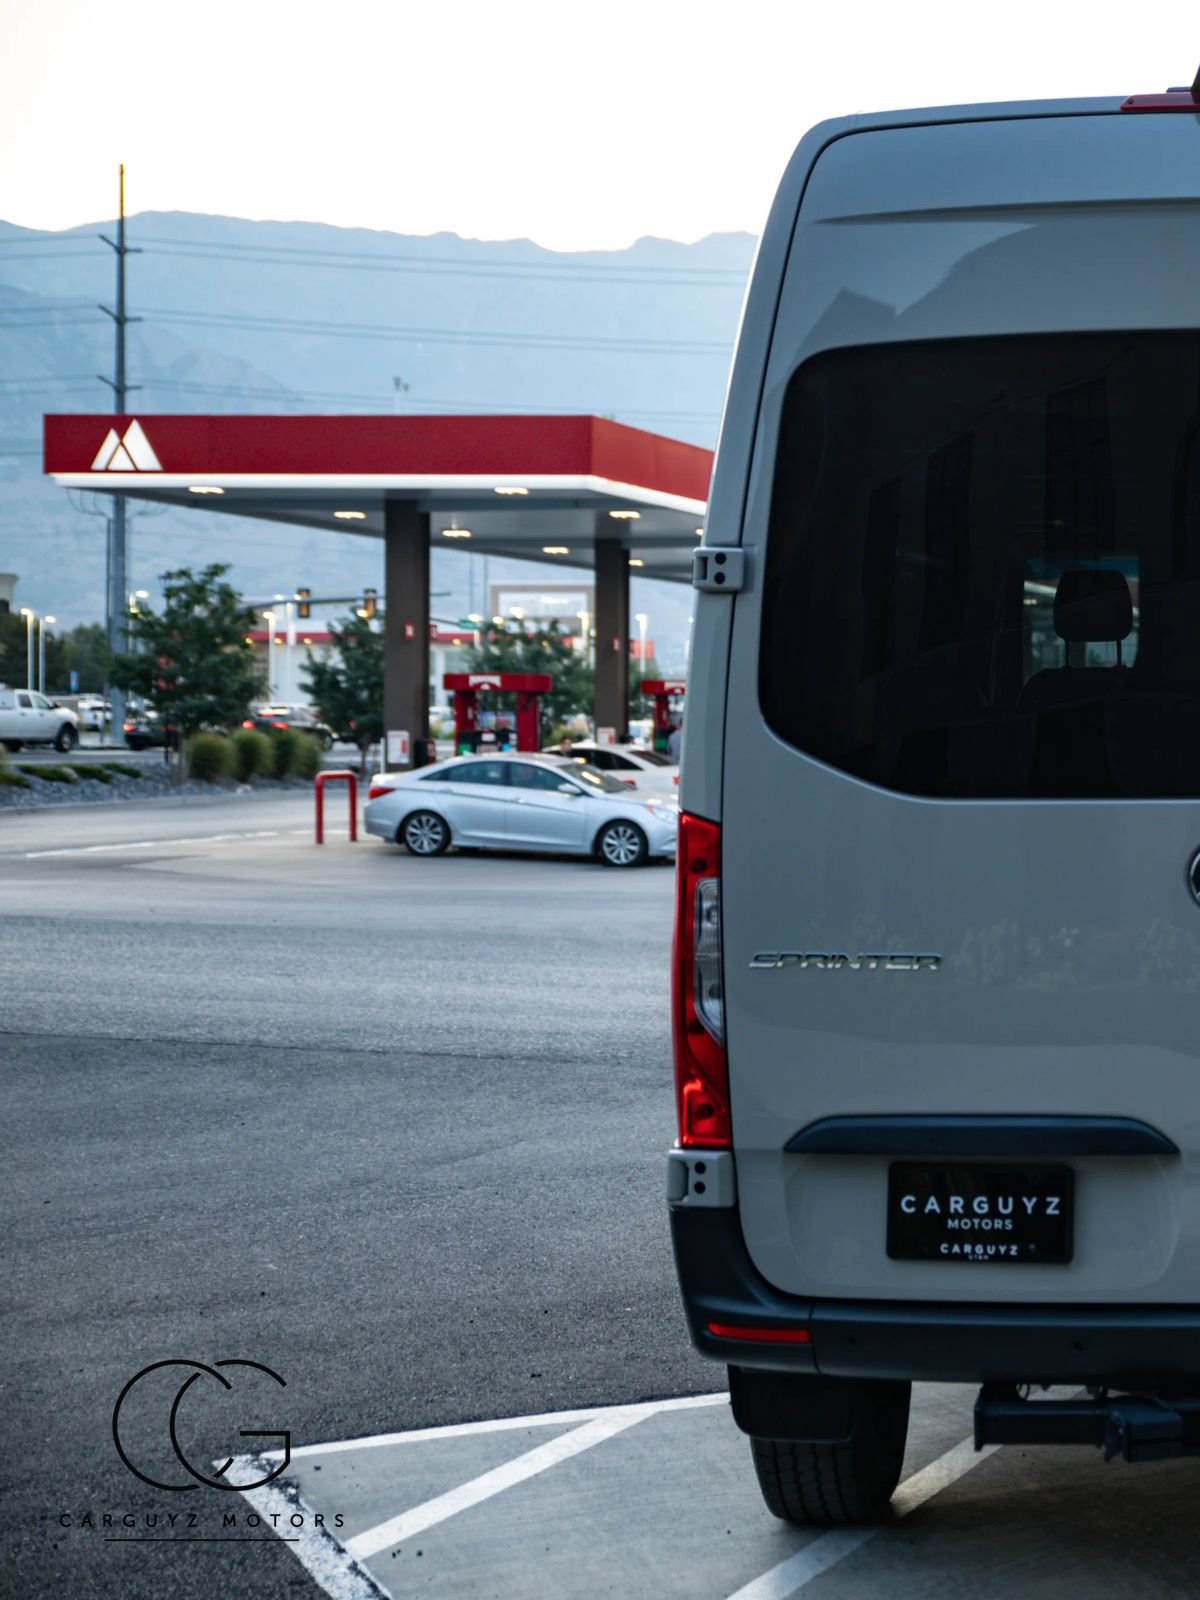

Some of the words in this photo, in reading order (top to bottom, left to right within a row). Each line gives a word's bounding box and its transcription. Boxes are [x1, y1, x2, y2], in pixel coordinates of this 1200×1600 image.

[749, 952, 943, 970] SPRINTER
[900, 1194, 1061, 1215] CARGUYZ
[947, 1218, 1013, 1231] MOTORS
[940, 1243, 1019, 1256] CARGUYZ
